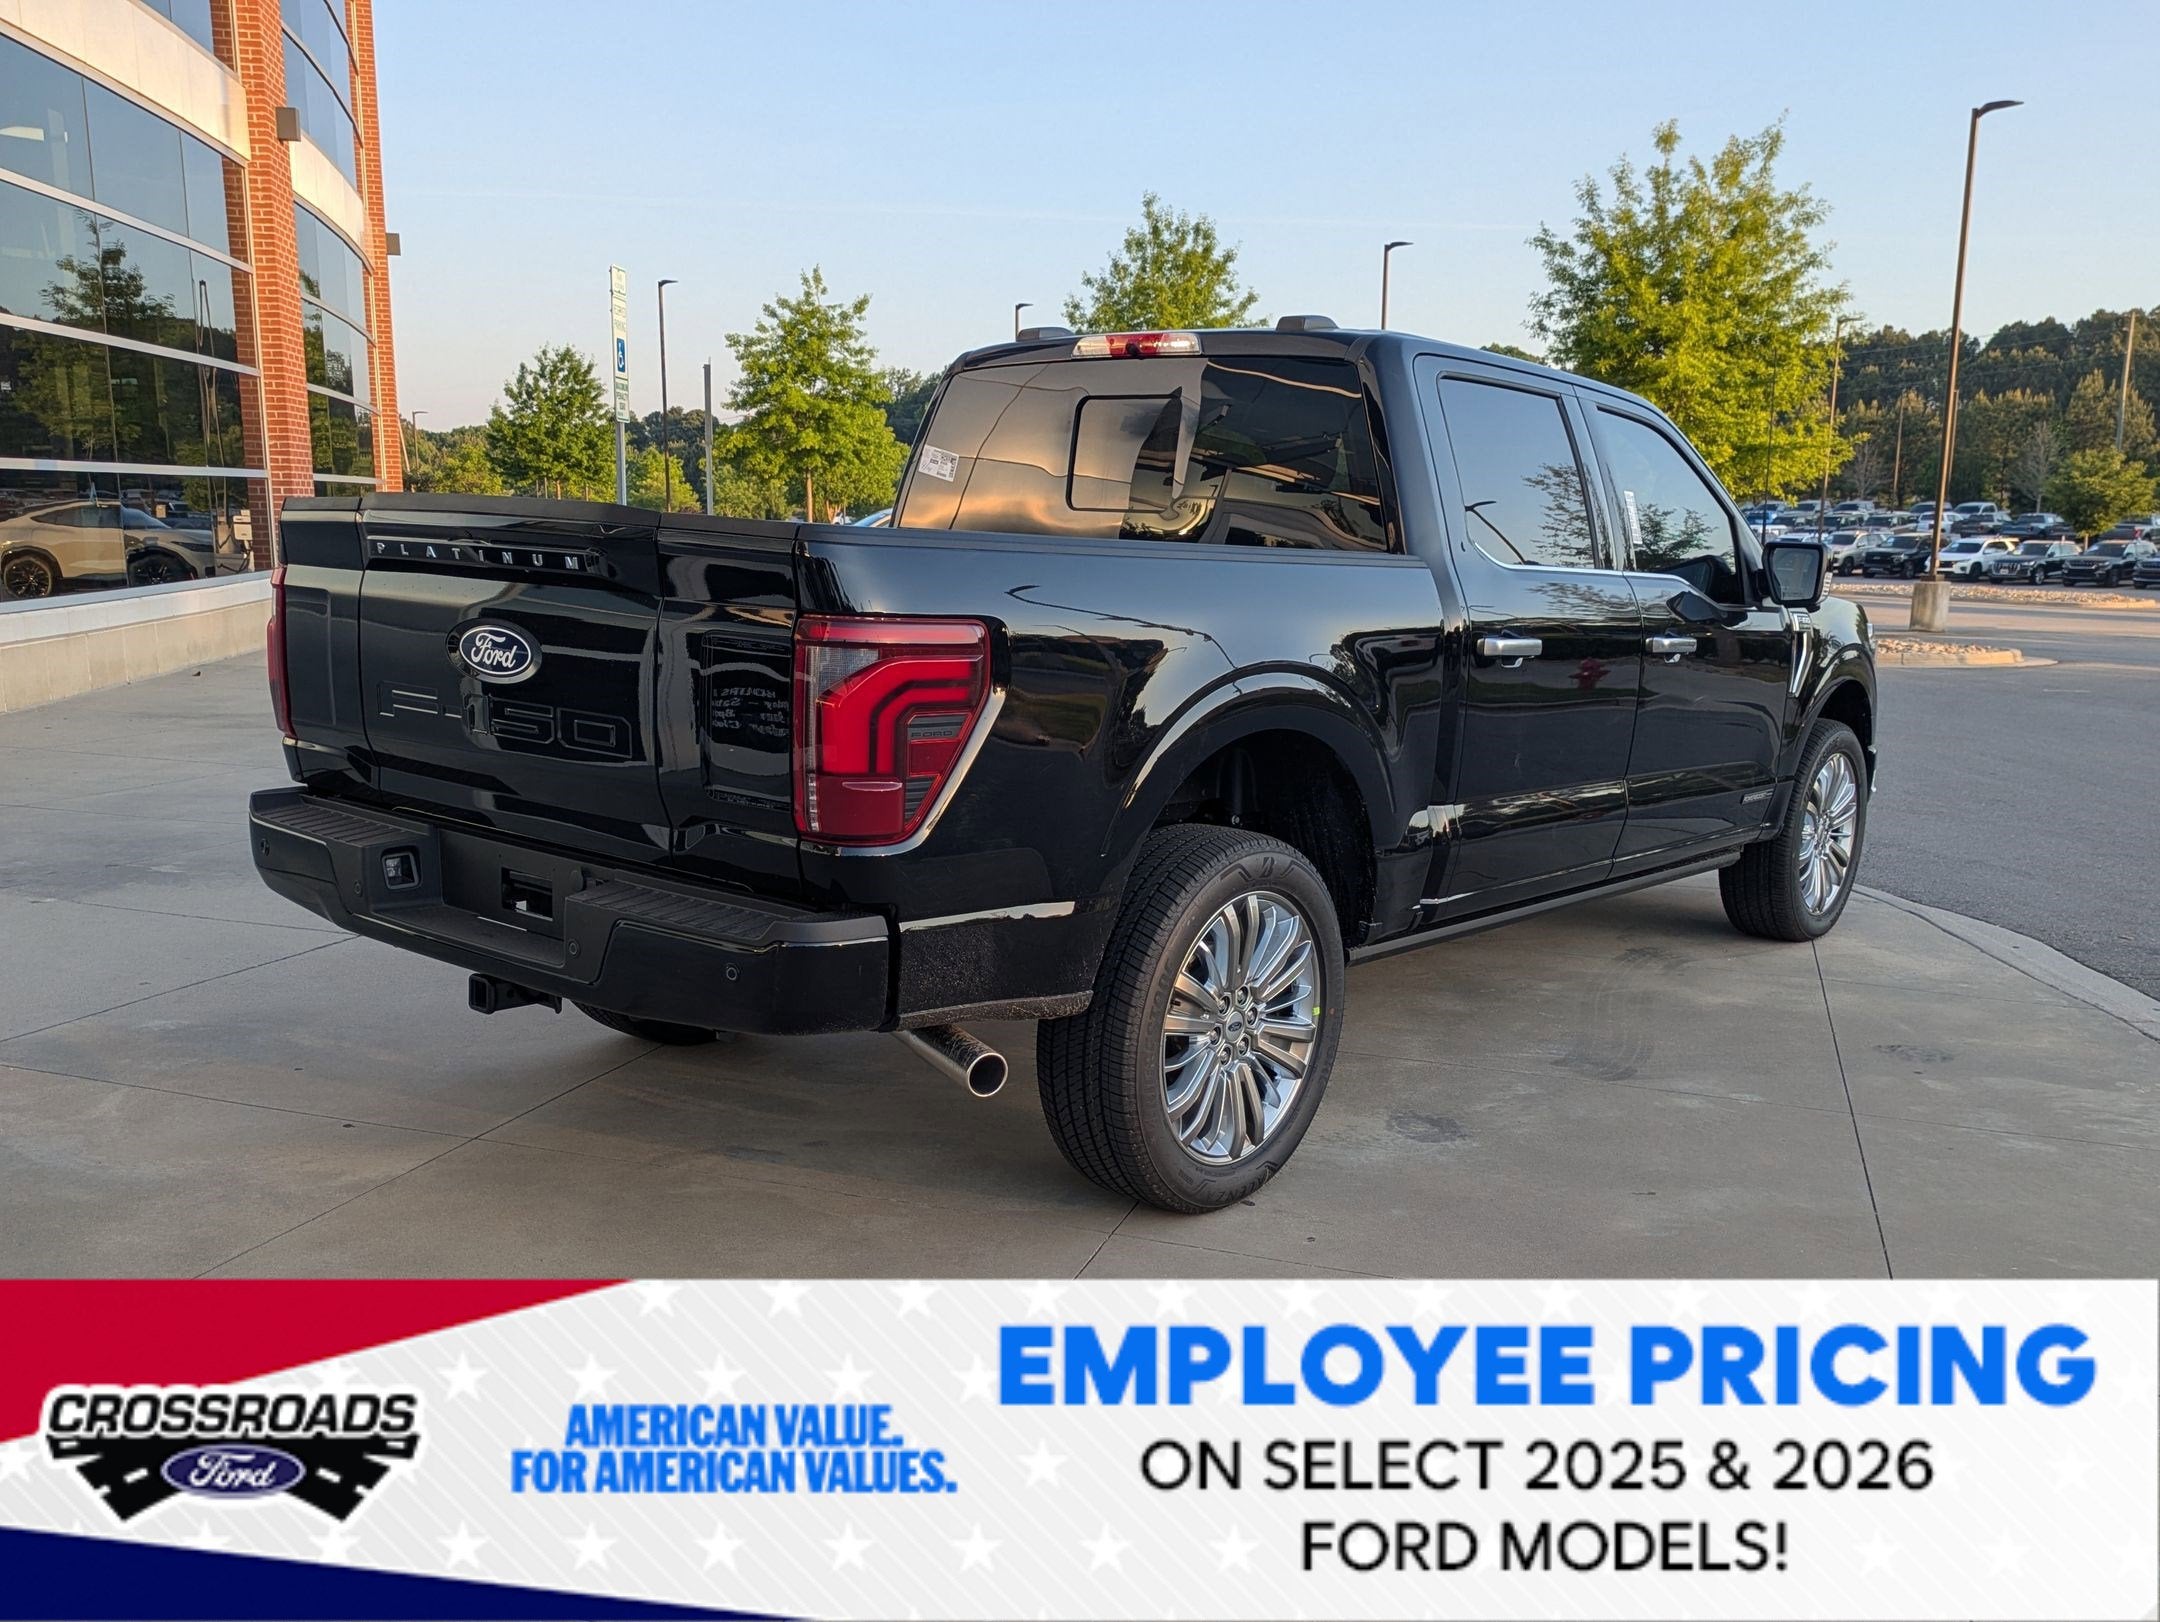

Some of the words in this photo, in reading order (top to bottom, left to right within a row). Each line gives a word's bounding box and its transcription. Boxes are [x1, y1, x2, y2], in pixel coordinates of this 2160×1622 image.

[376, 541, 580, 570] PLATINUM
[470, 631, 519, 669] Ford
[377, 680, 633, 759] F-150
[910, 728, 954, 739] FORD
